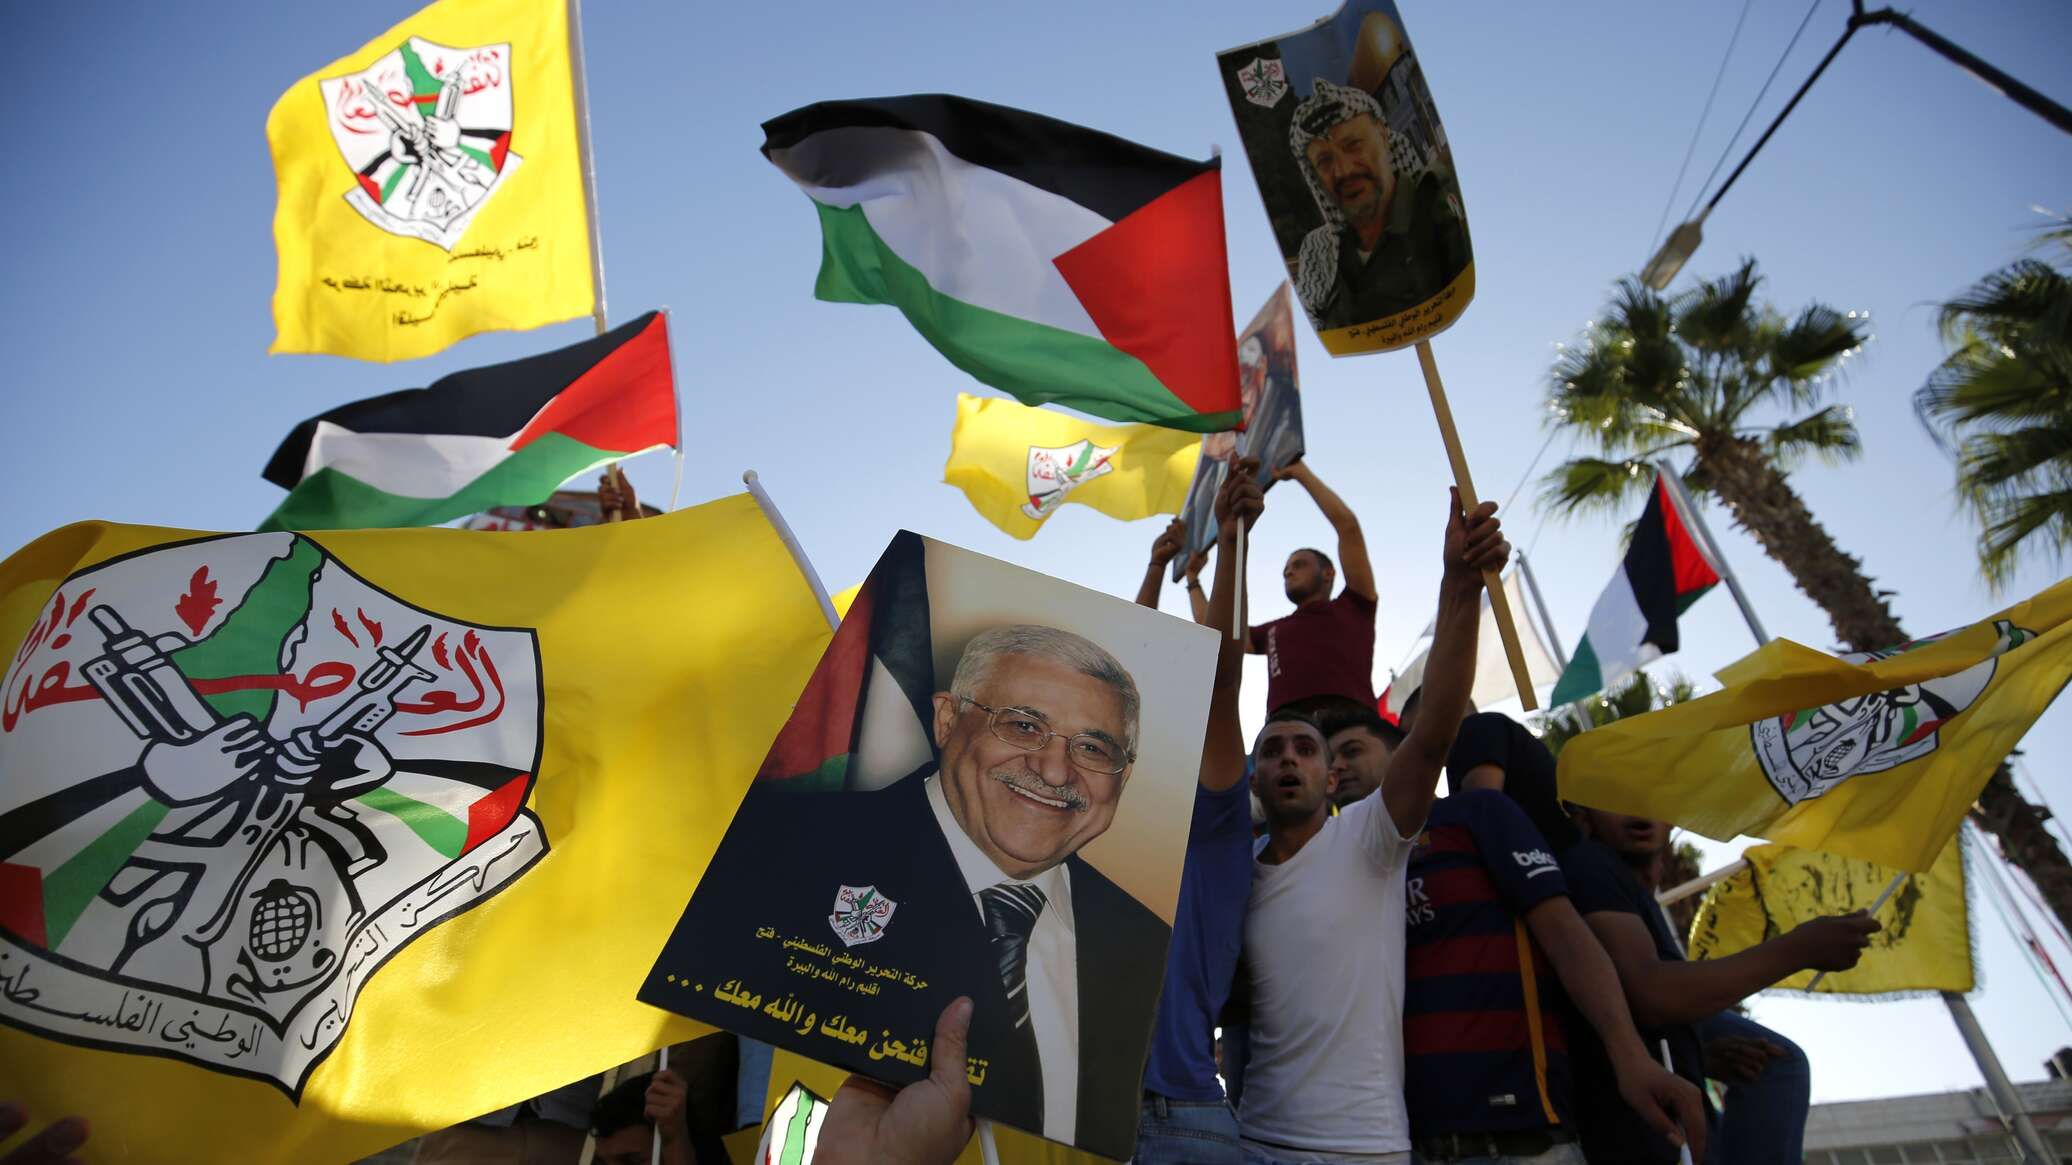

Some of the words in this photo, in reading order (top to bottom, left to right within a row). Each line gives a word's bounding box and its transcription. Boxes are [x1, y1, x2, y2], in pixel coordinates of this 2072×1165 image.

[755, 926, 776, 939] فتح
[783, 935, 832, 957] الفلسطيني
[786, 955, 820, 979] والبيرة
[831, 952, 865, 969] الوطني
[821, 967, 839, 982] الله
[838, 975, 855, 990] رام
[864, 964, 901, 981] التحرير
[903, 971, 929, 991] حركة
[714, 978, 760, 1011] معك
[857, 982, 881, 997] اقليم
[763, 991, 817, 1036] والله
[160, 1009, 264, 1059] الوطني
[821, 1014, 867, 1047] معك
[869, 1029, 929, 1067] فنحن
